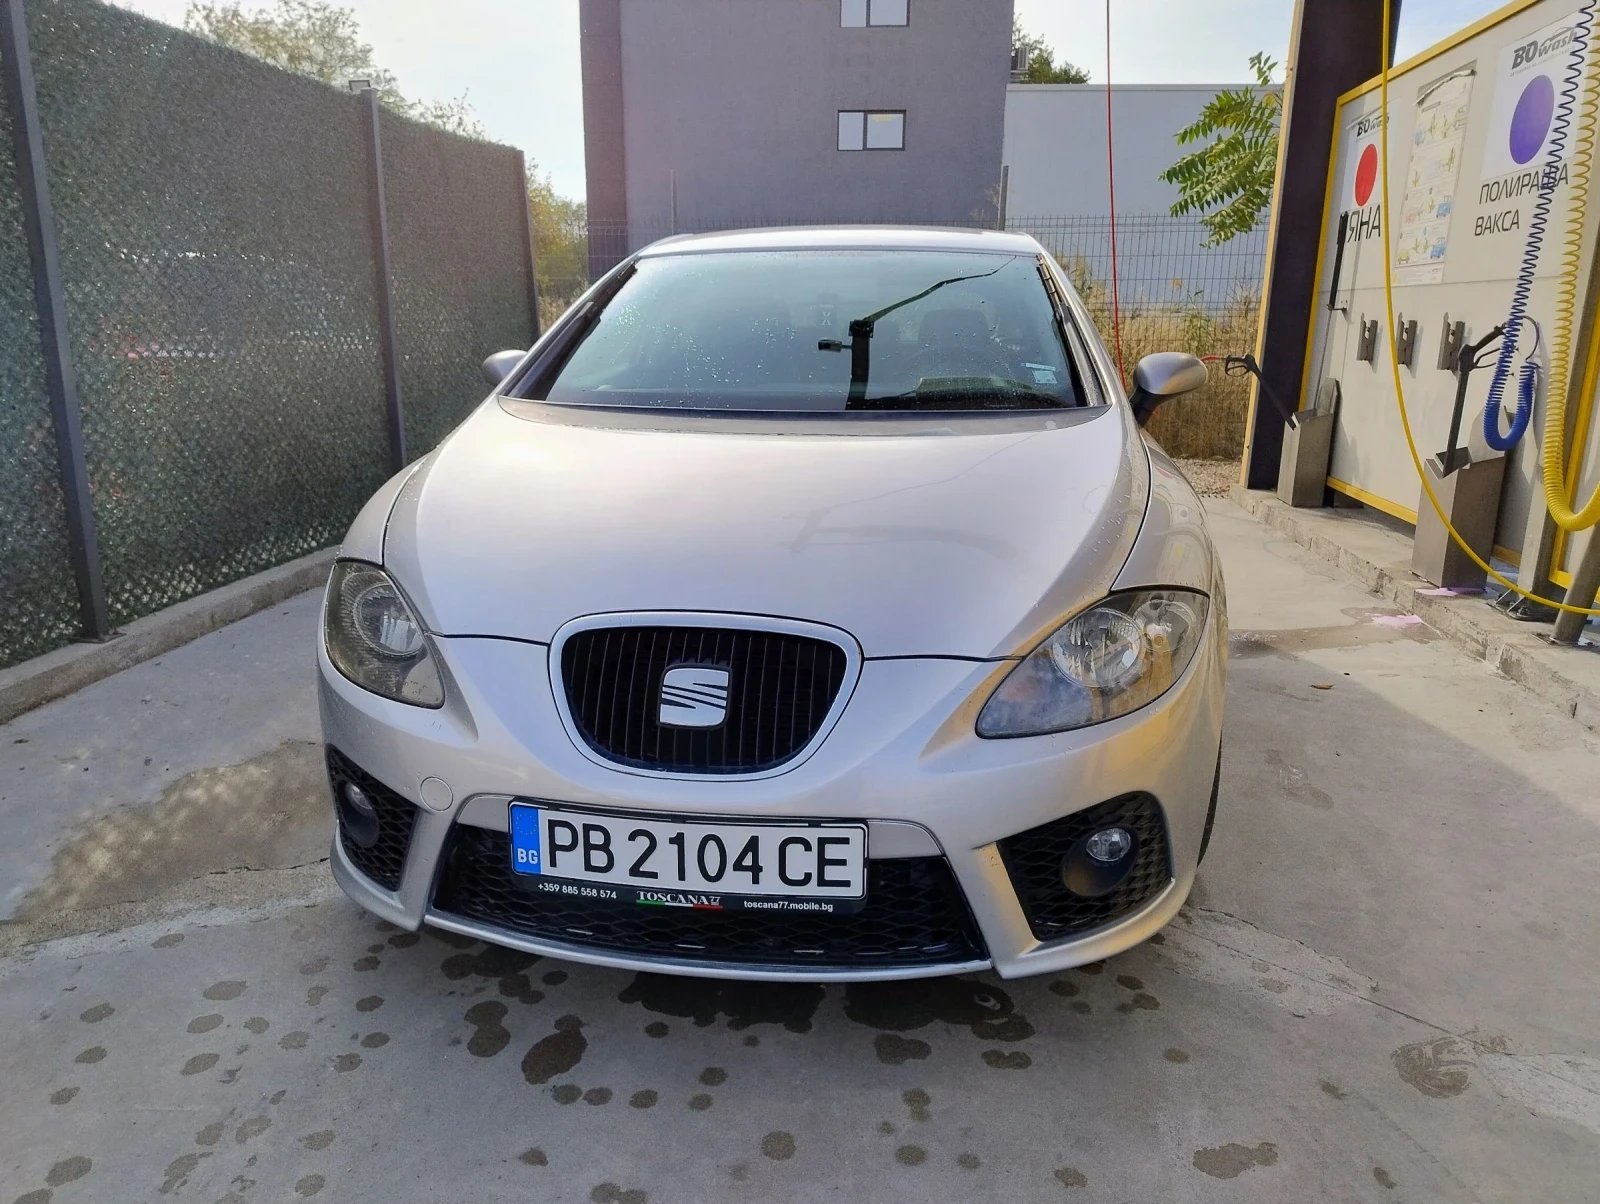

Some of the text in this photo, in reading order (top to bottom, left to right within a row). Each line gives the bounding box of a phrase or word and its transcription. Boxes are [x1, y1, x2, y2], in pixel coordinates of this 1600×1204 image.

[1343, 204, 1381, 243] ЯНА
[1474, 208, 1520, 237] ВАКСА
[517, 847, 539, 865] BG
[547, 818, 852, 888] PB 2104 CE
[537, 882, 618, 900] +359 885 558 574
[743, 899, 834, 913] toscana77.mobile.bg
